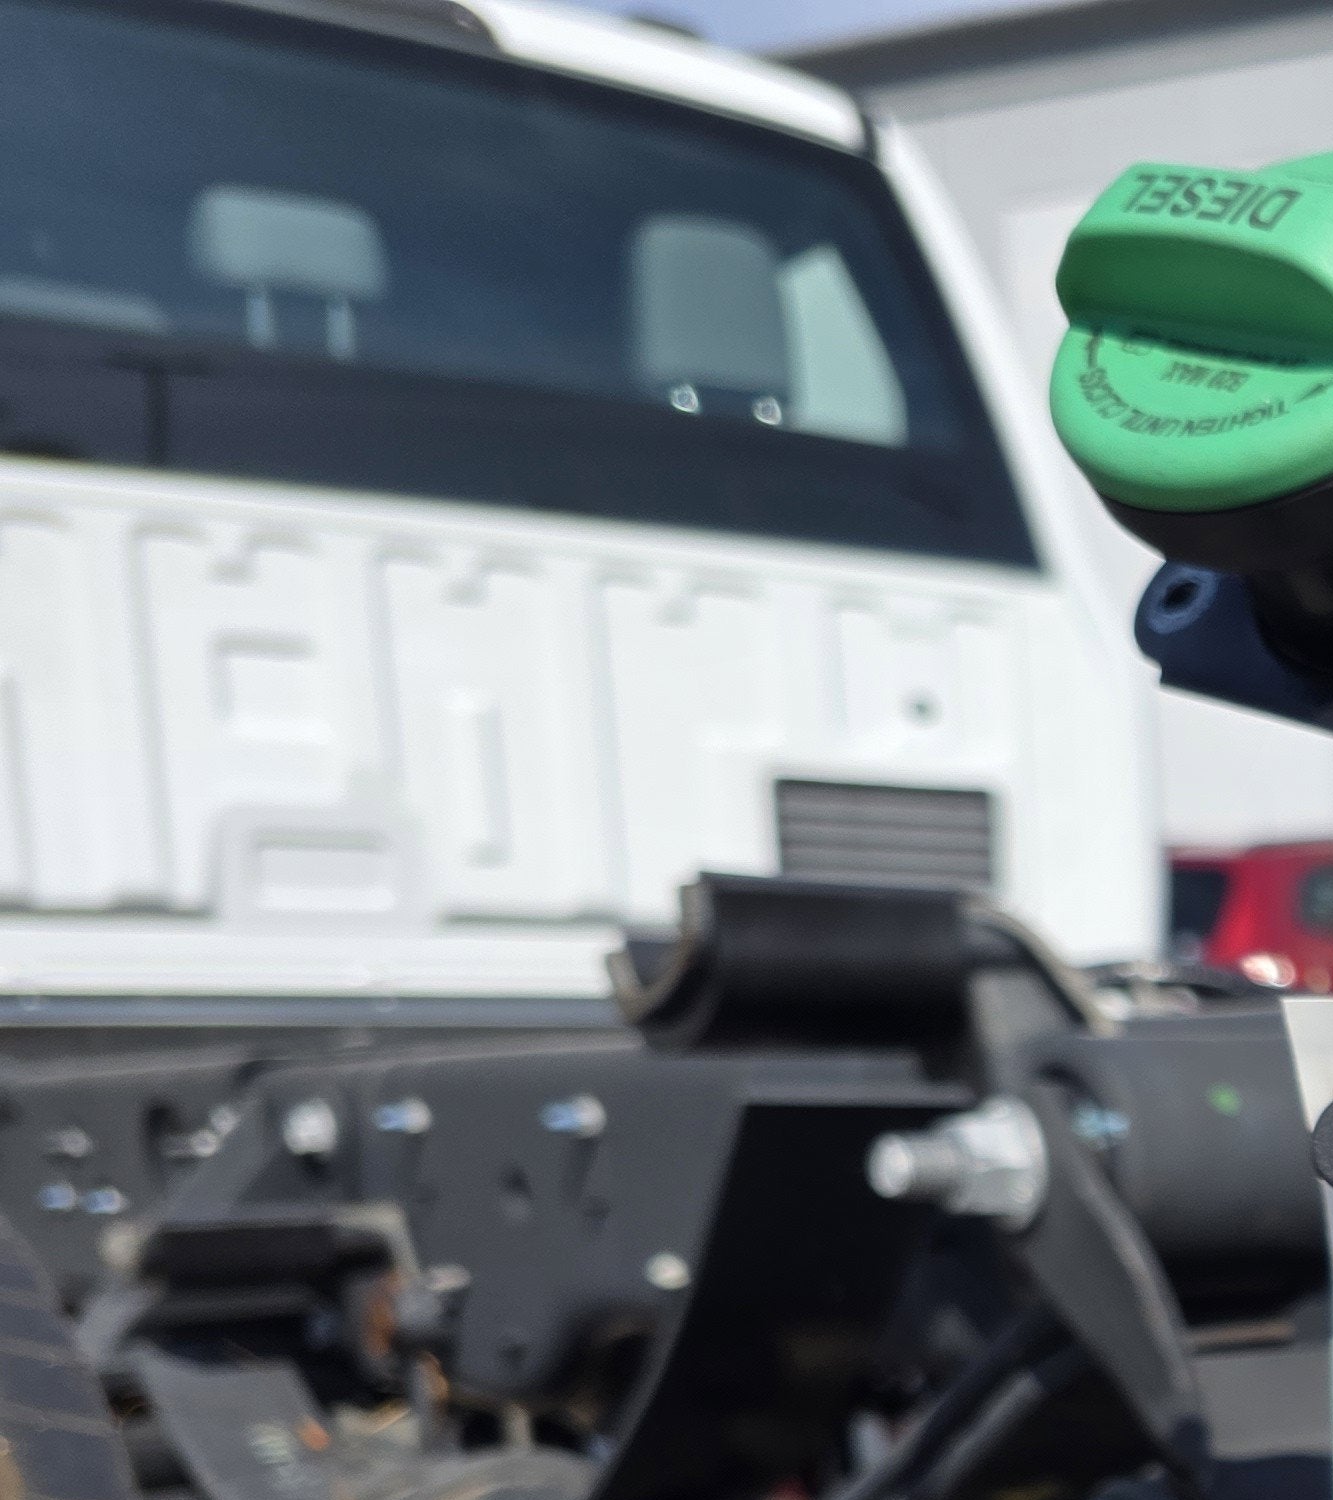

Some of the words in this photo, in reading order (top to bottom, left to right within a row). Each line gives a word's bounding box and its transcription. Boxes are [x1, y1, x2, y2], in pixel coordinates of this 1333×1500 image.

[1123, 173, 1303, 232] DIESEL
[1160, 362, 1210, 387] MAX
[1120, 410, 1180, 437] UNTIL
[1179, 400, 1289, 437] TIGHTEN
